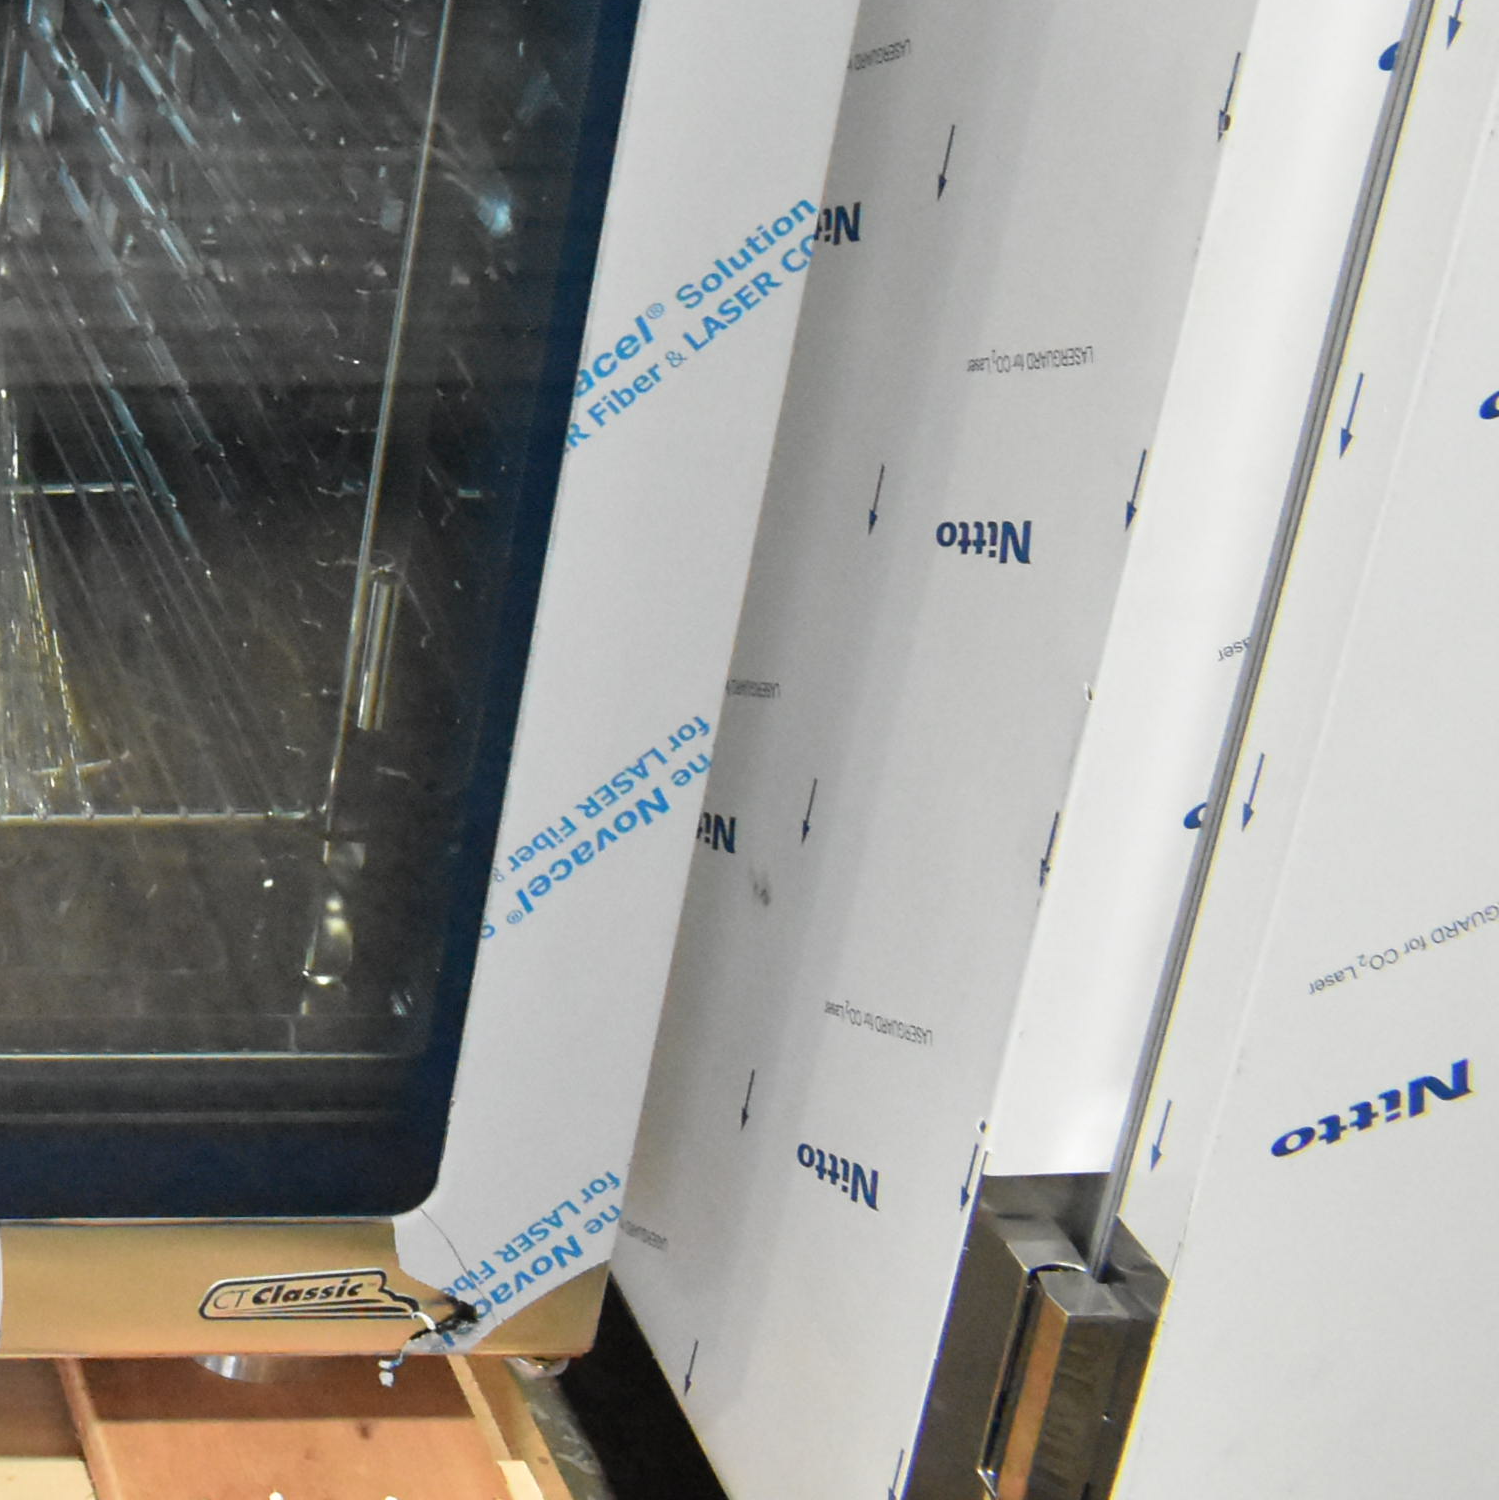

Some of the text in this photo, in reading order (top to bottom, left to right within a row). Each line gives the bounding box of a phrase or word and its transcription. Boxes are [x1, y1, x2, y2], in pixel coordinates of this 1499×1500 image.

[676, 199, 816, 310] Solution
[587, 271, 782, 427] Fiber & LASER
[936, 519, 1031, 565] Nitto
[507, 716, 710, 872] for LASER Fiber
[1404, 935, 1427, 954] for
[1309, 966, 1358, 995] Laser
[1271, 1058, 1474, 1158] Nitto
[581, 1171, 621, 1204] for
[797, 1142, 879, 1211] Nitto
[494, 1200, 581, 1263] LASER
[213, 1278, 363, 1310] CT Classic
